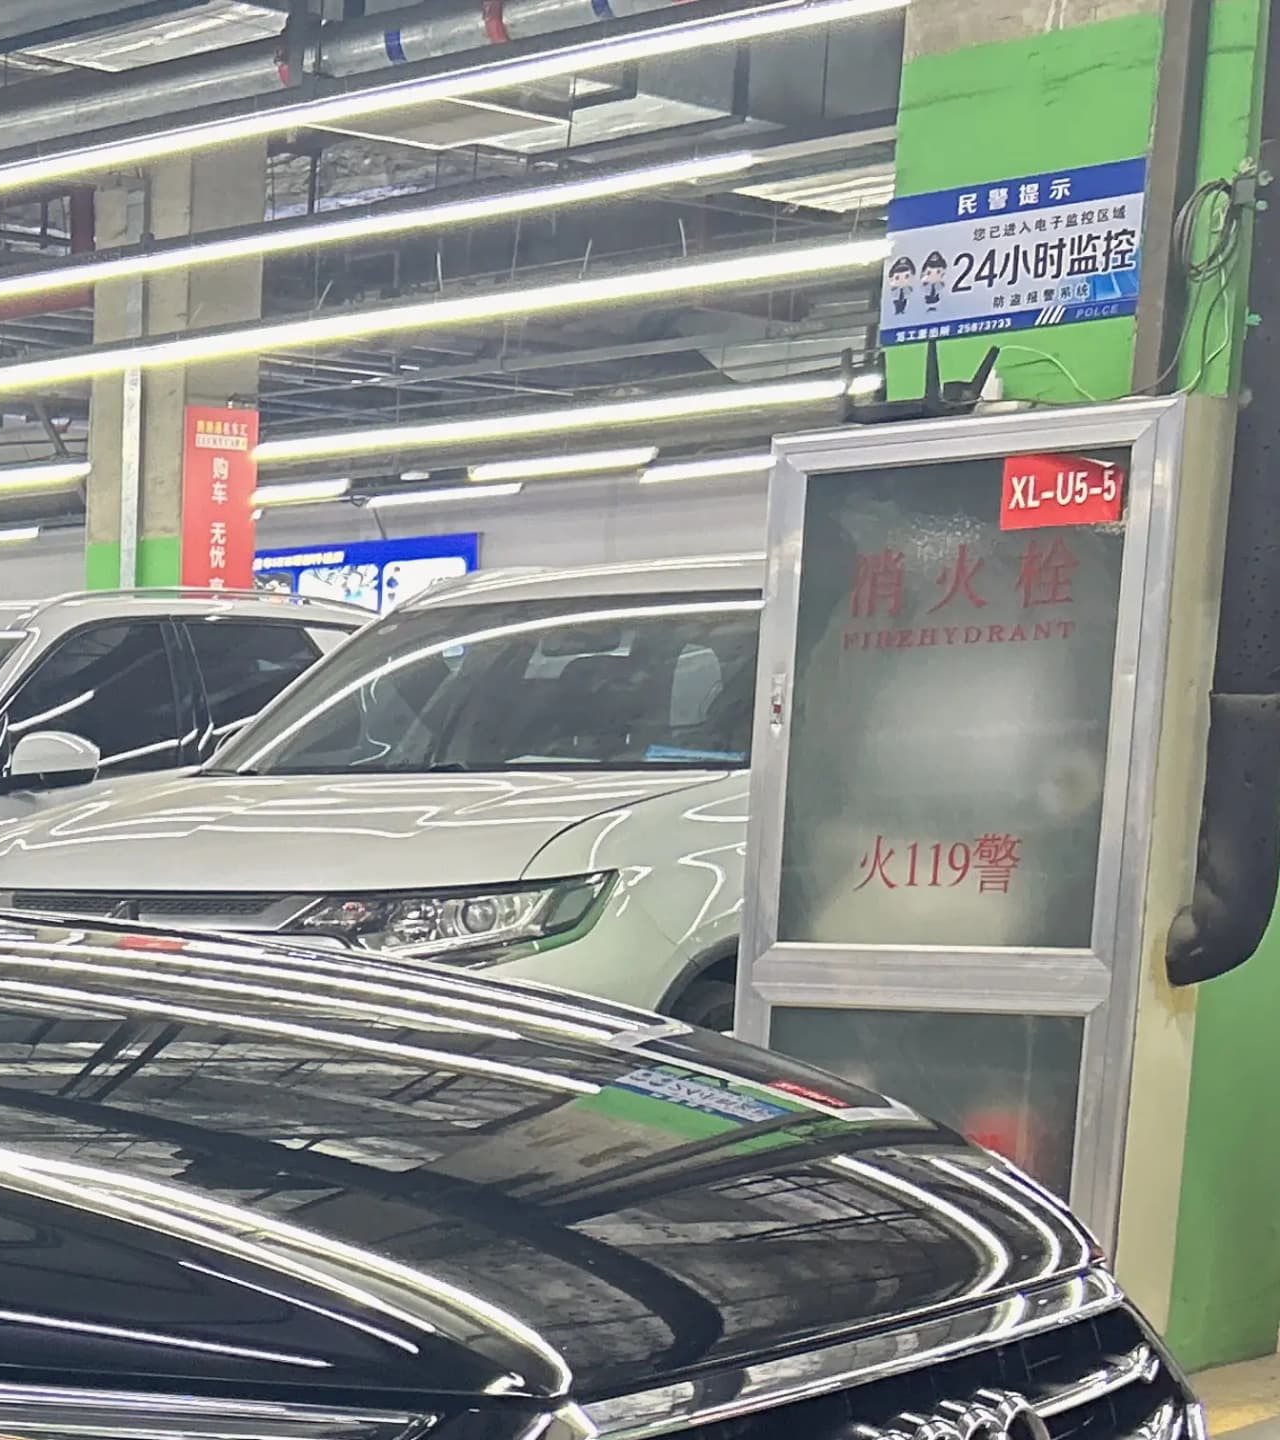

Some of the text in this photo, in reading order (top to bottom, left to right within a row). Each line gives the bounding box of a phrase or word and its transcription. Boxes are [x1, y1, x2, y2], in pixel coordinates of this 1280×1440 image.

[957, 177, 1072, 215] 民警提示
[972, 205, 1127, 242] 您已进入电子监控区域
[951, 229, 1136, 293] 24小时监控
[992, 284, 1089, 309] 防盗报警系统
[211, 457, 229, 504] 购车
[1008, 468, 1117, 510] XL-U5-5
[210, 521, 229, 569] 无忧
[848, 536, 1080, 619] 消火栓
[853, 833, 1022, 895] 火119警
